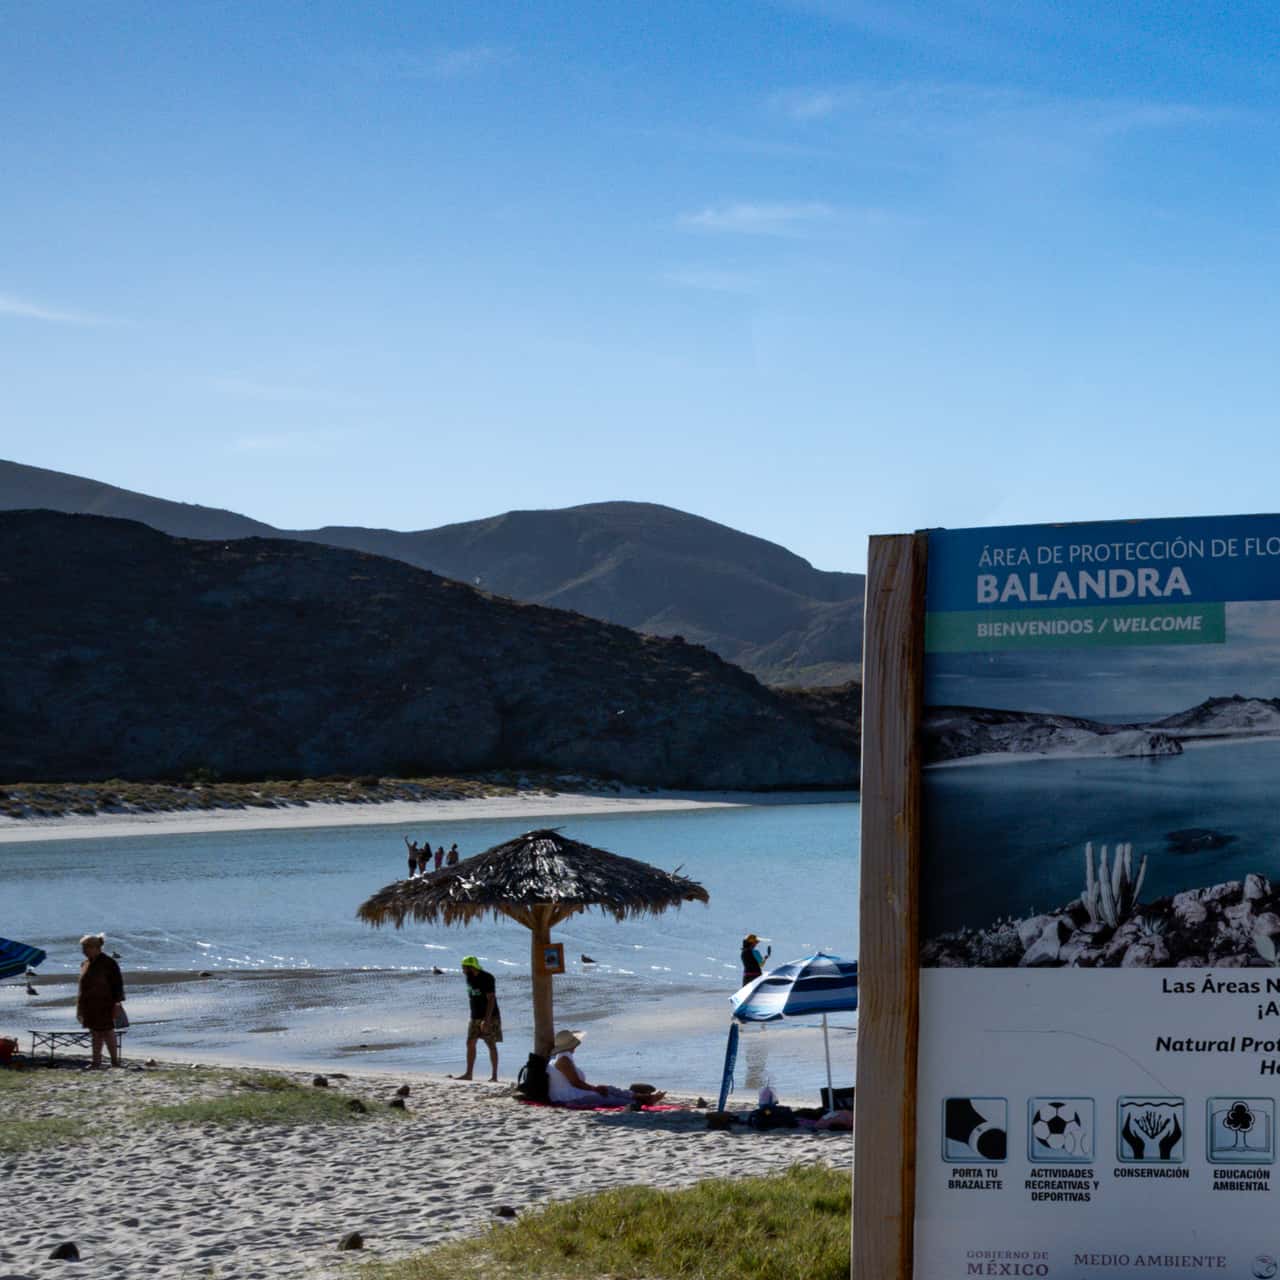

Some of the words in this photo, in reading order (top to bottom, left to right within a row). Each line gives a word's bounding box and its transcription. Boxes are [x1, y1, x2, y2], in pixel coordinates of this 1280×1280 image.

[977, 544, 1032, 568] ÁREA
[1037, 545, 1064, 565] DE
[1068, 536, 1205, 564] PROTECCIÓN
[1210, 538, 1239, 558] DE
[976, 566, 1192, 604] BALANDRA
[977, 618, 1095, 638] BIENVENIDOS
[1097, 617, 1109, 633] /
[1112, 615, 1203, 633] WELCOME
[1162, 978, 1196, 994] Las
[1201, 973, 1261, 994] Áreas
[1155, 1036, 1236, 1052] Natural
[952, 1168, 984, 1178] PORTA
[985, 1168, 998, 1178] TU
[1030, 1168, 1094, 1179] ACTIVIDADES
[1113, 1166, 1190, 1179] CONSERVACIÓN
[1213, 1168, 1270, 1180] EDUCACIÓN
[948, 1179, 1002, 1190] BRAZALETE
[1024, 1180, 1090, 1191] RECREATIVAS
[1093, 1181, 1100, 1190] Y
[1212, 1181, 1270, 1191] AMBIENTAL
[1031, 1191, 1091, 1202] DEPORTIVAS
[966, 1250, 1030, 1260] GOBIERNO
[1032, 1251, 1049, 1261] DE
[1074, 1253, 1130, 1267] MEDIO
[1133, 1255, 1227, 1269] AMBIENTE
[967, 1259, 1049, 1280] MÉXICO
